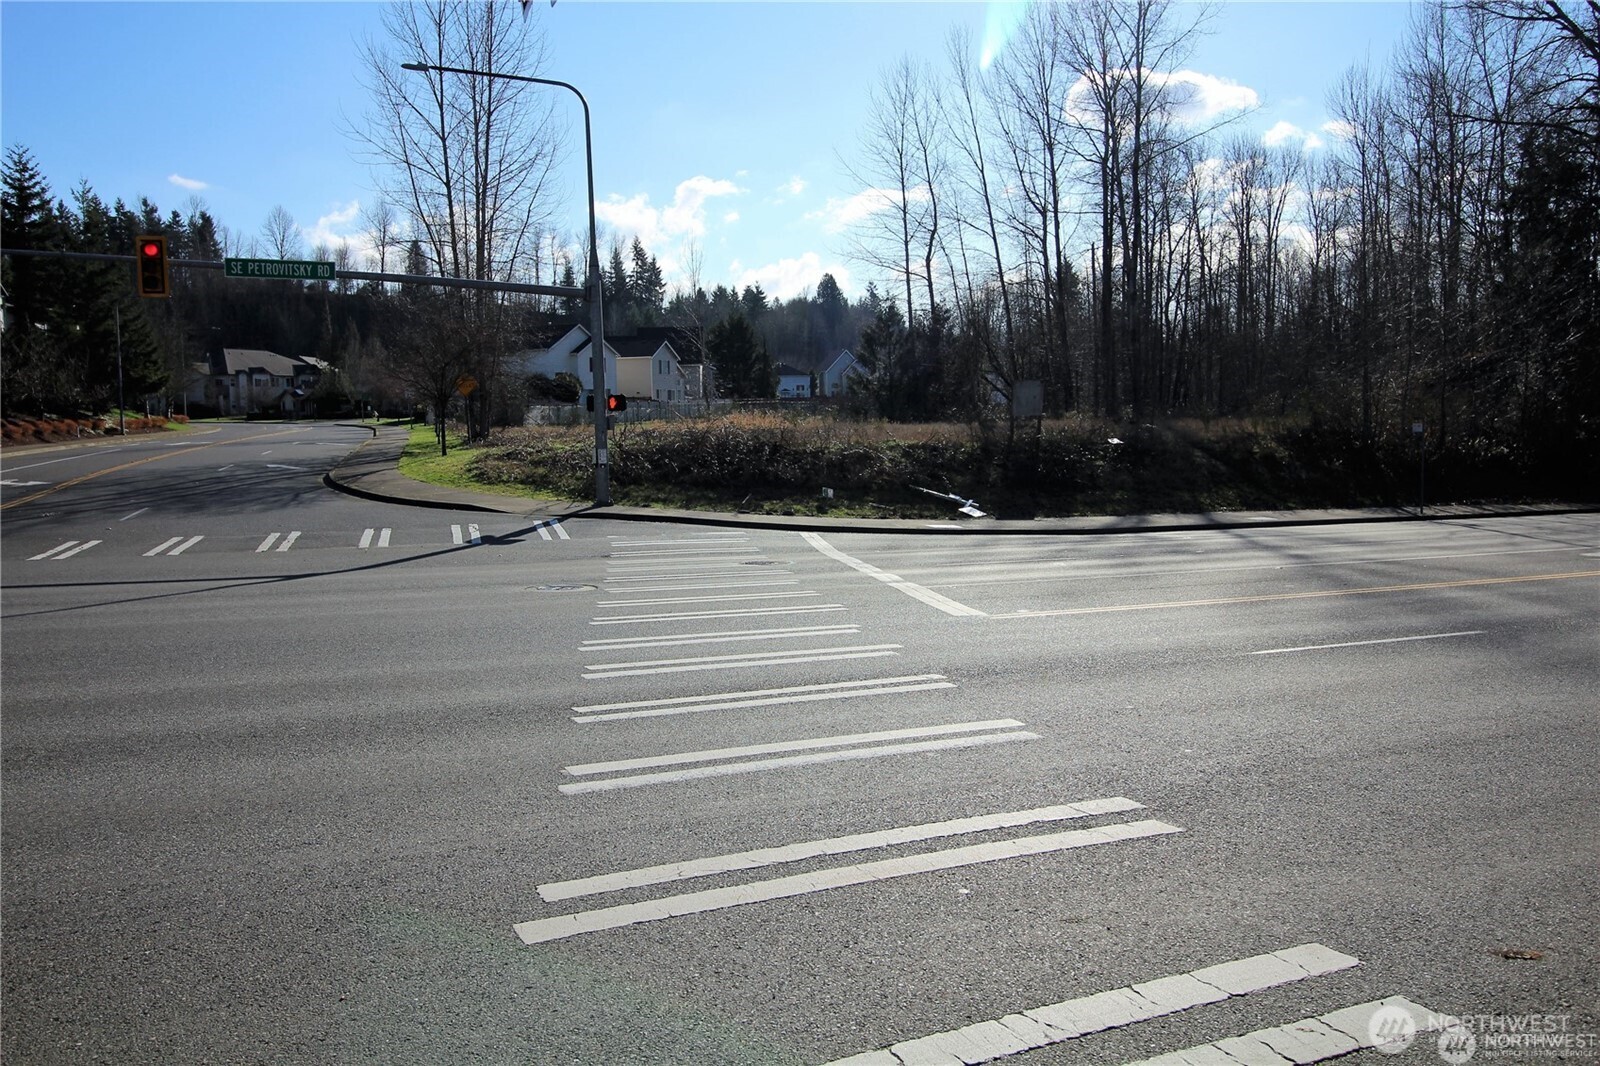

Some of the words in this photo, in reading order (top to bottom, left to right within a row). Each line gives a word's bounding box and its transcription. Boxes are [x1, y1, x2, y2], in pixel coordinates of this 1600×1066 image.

[231, 261, 243, 274] SE
[248, 262, 312, 276] PETROVITSKY
[317, 265, 330, 277] RD
